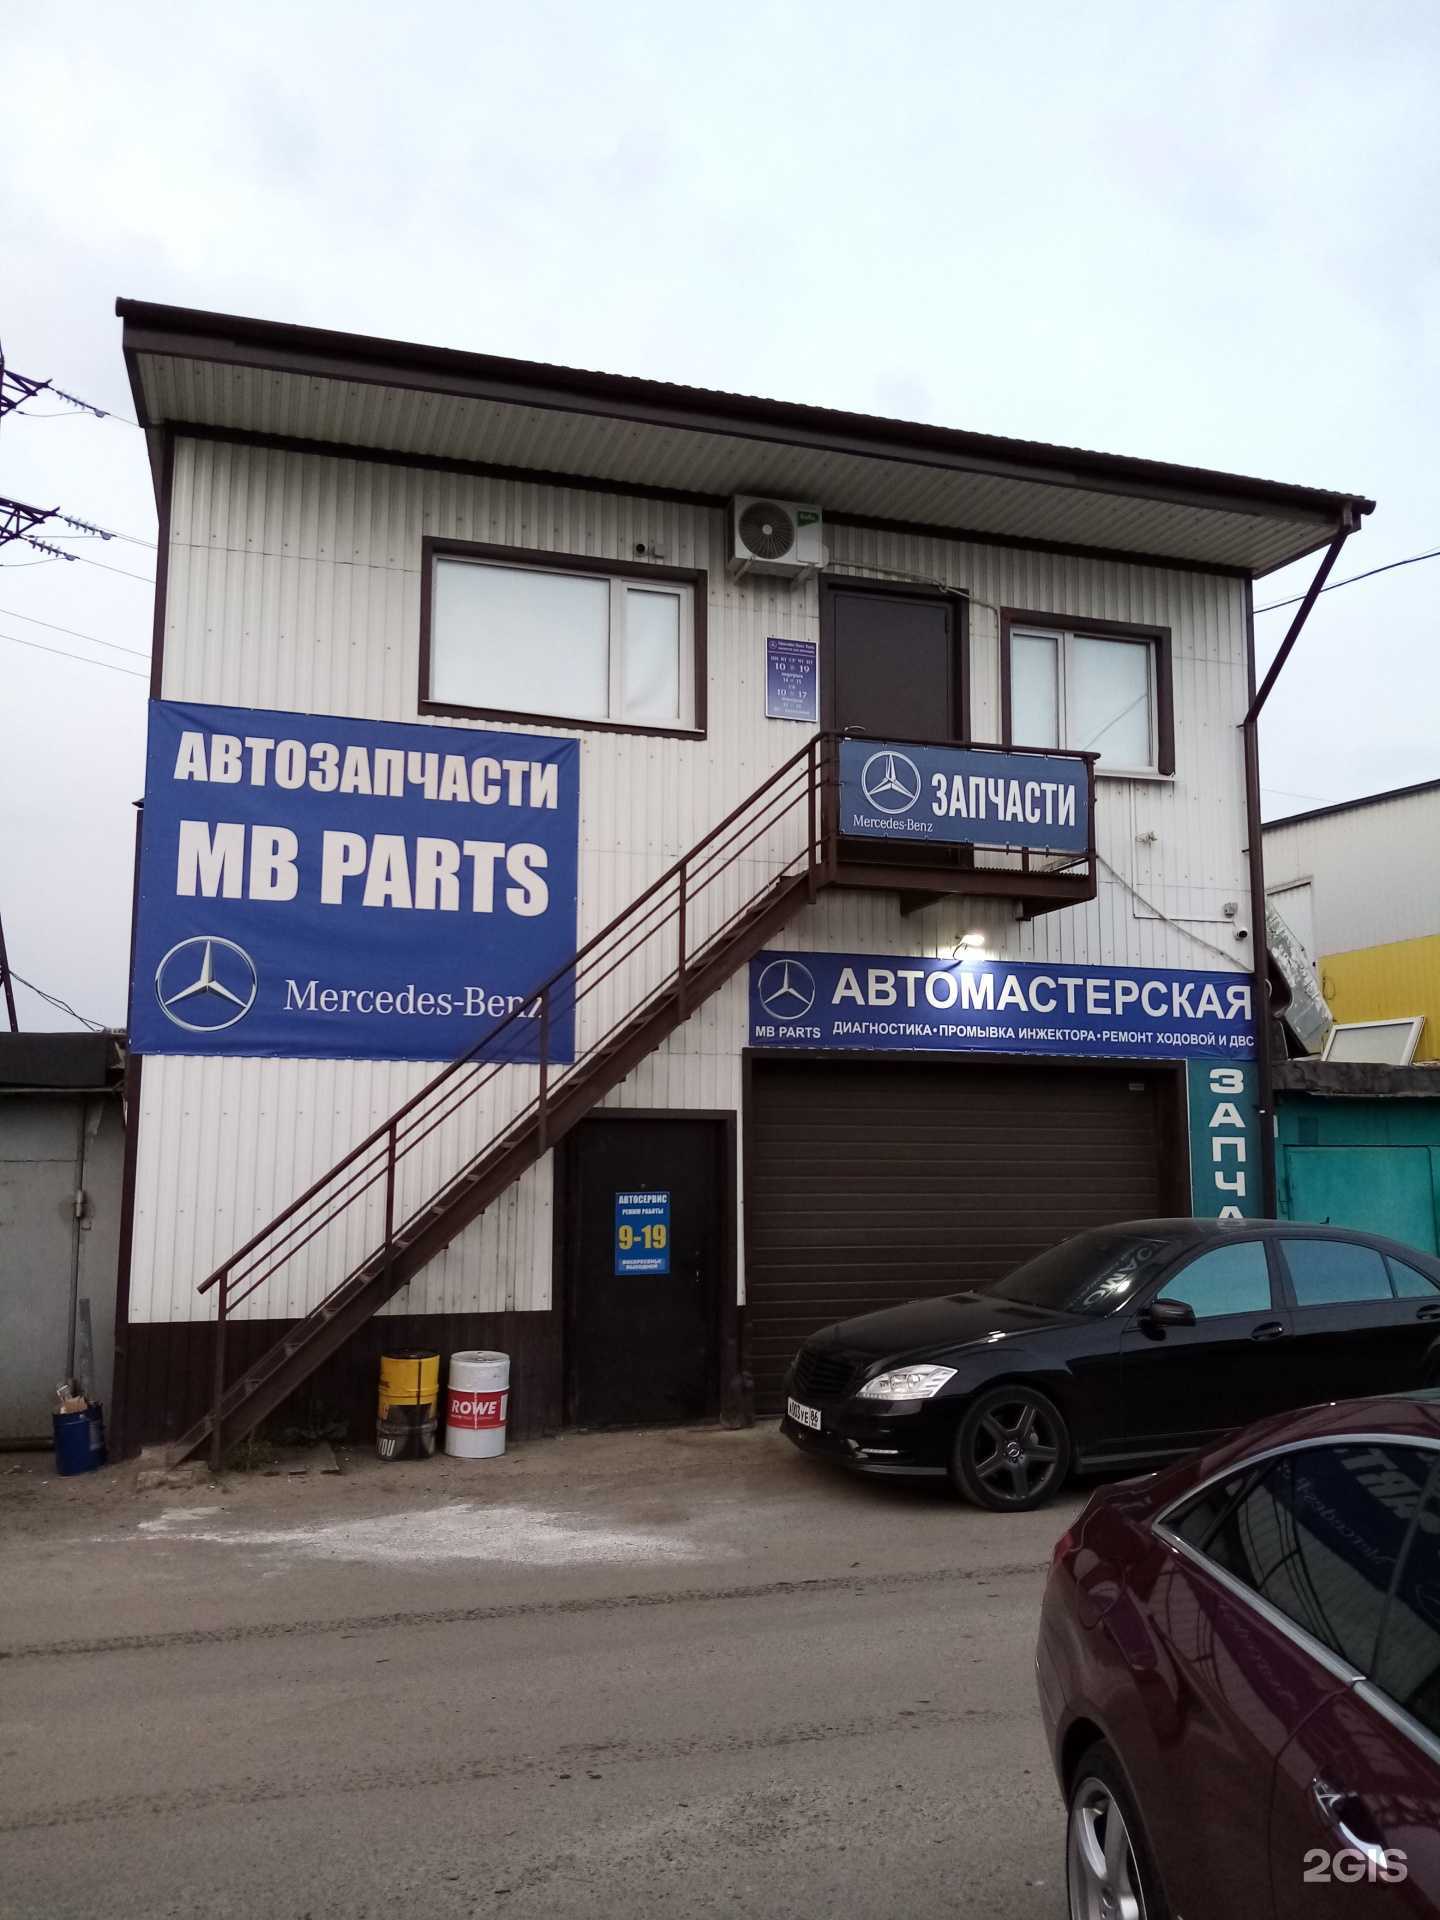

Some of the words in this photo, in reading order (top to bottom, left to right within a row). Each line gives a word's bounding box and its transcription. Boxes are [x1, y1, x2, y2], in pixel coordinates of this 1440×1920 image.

[173, 731, 558, 809] АВТОЗАПЧАСТИ
[931, 773, 1076, 827] ЗАПЧАСТИ
[853, 814, 933, 833] Mercedes-Benz
[176, 819, 299, 902] MB
[321, 830, 549, 917] PARTS
[831, 967, 1253, 1021] АВТОМАСТЕРСКАЯ
[755, 1025, 775, 1038] MB
[778, 1026, 821, 1039] PARTS
[1018, 1028, 1096, 1041] ИНЖЕКТОРА
[1102, 1030, 1153, 1043] РЕМОНТ
[1156, 1032, 1216, 1046] ХОДОВОЙ
[1218, 1034, 1227, 1046] И
[1229, 1034, 1255, 1048] ДВС
[619, 1195, 667, 1204] АВТОСЕРВИС
[618, 1224, 667, 1250] 9-19
[451, 1400, 497, 1416] ROWE
